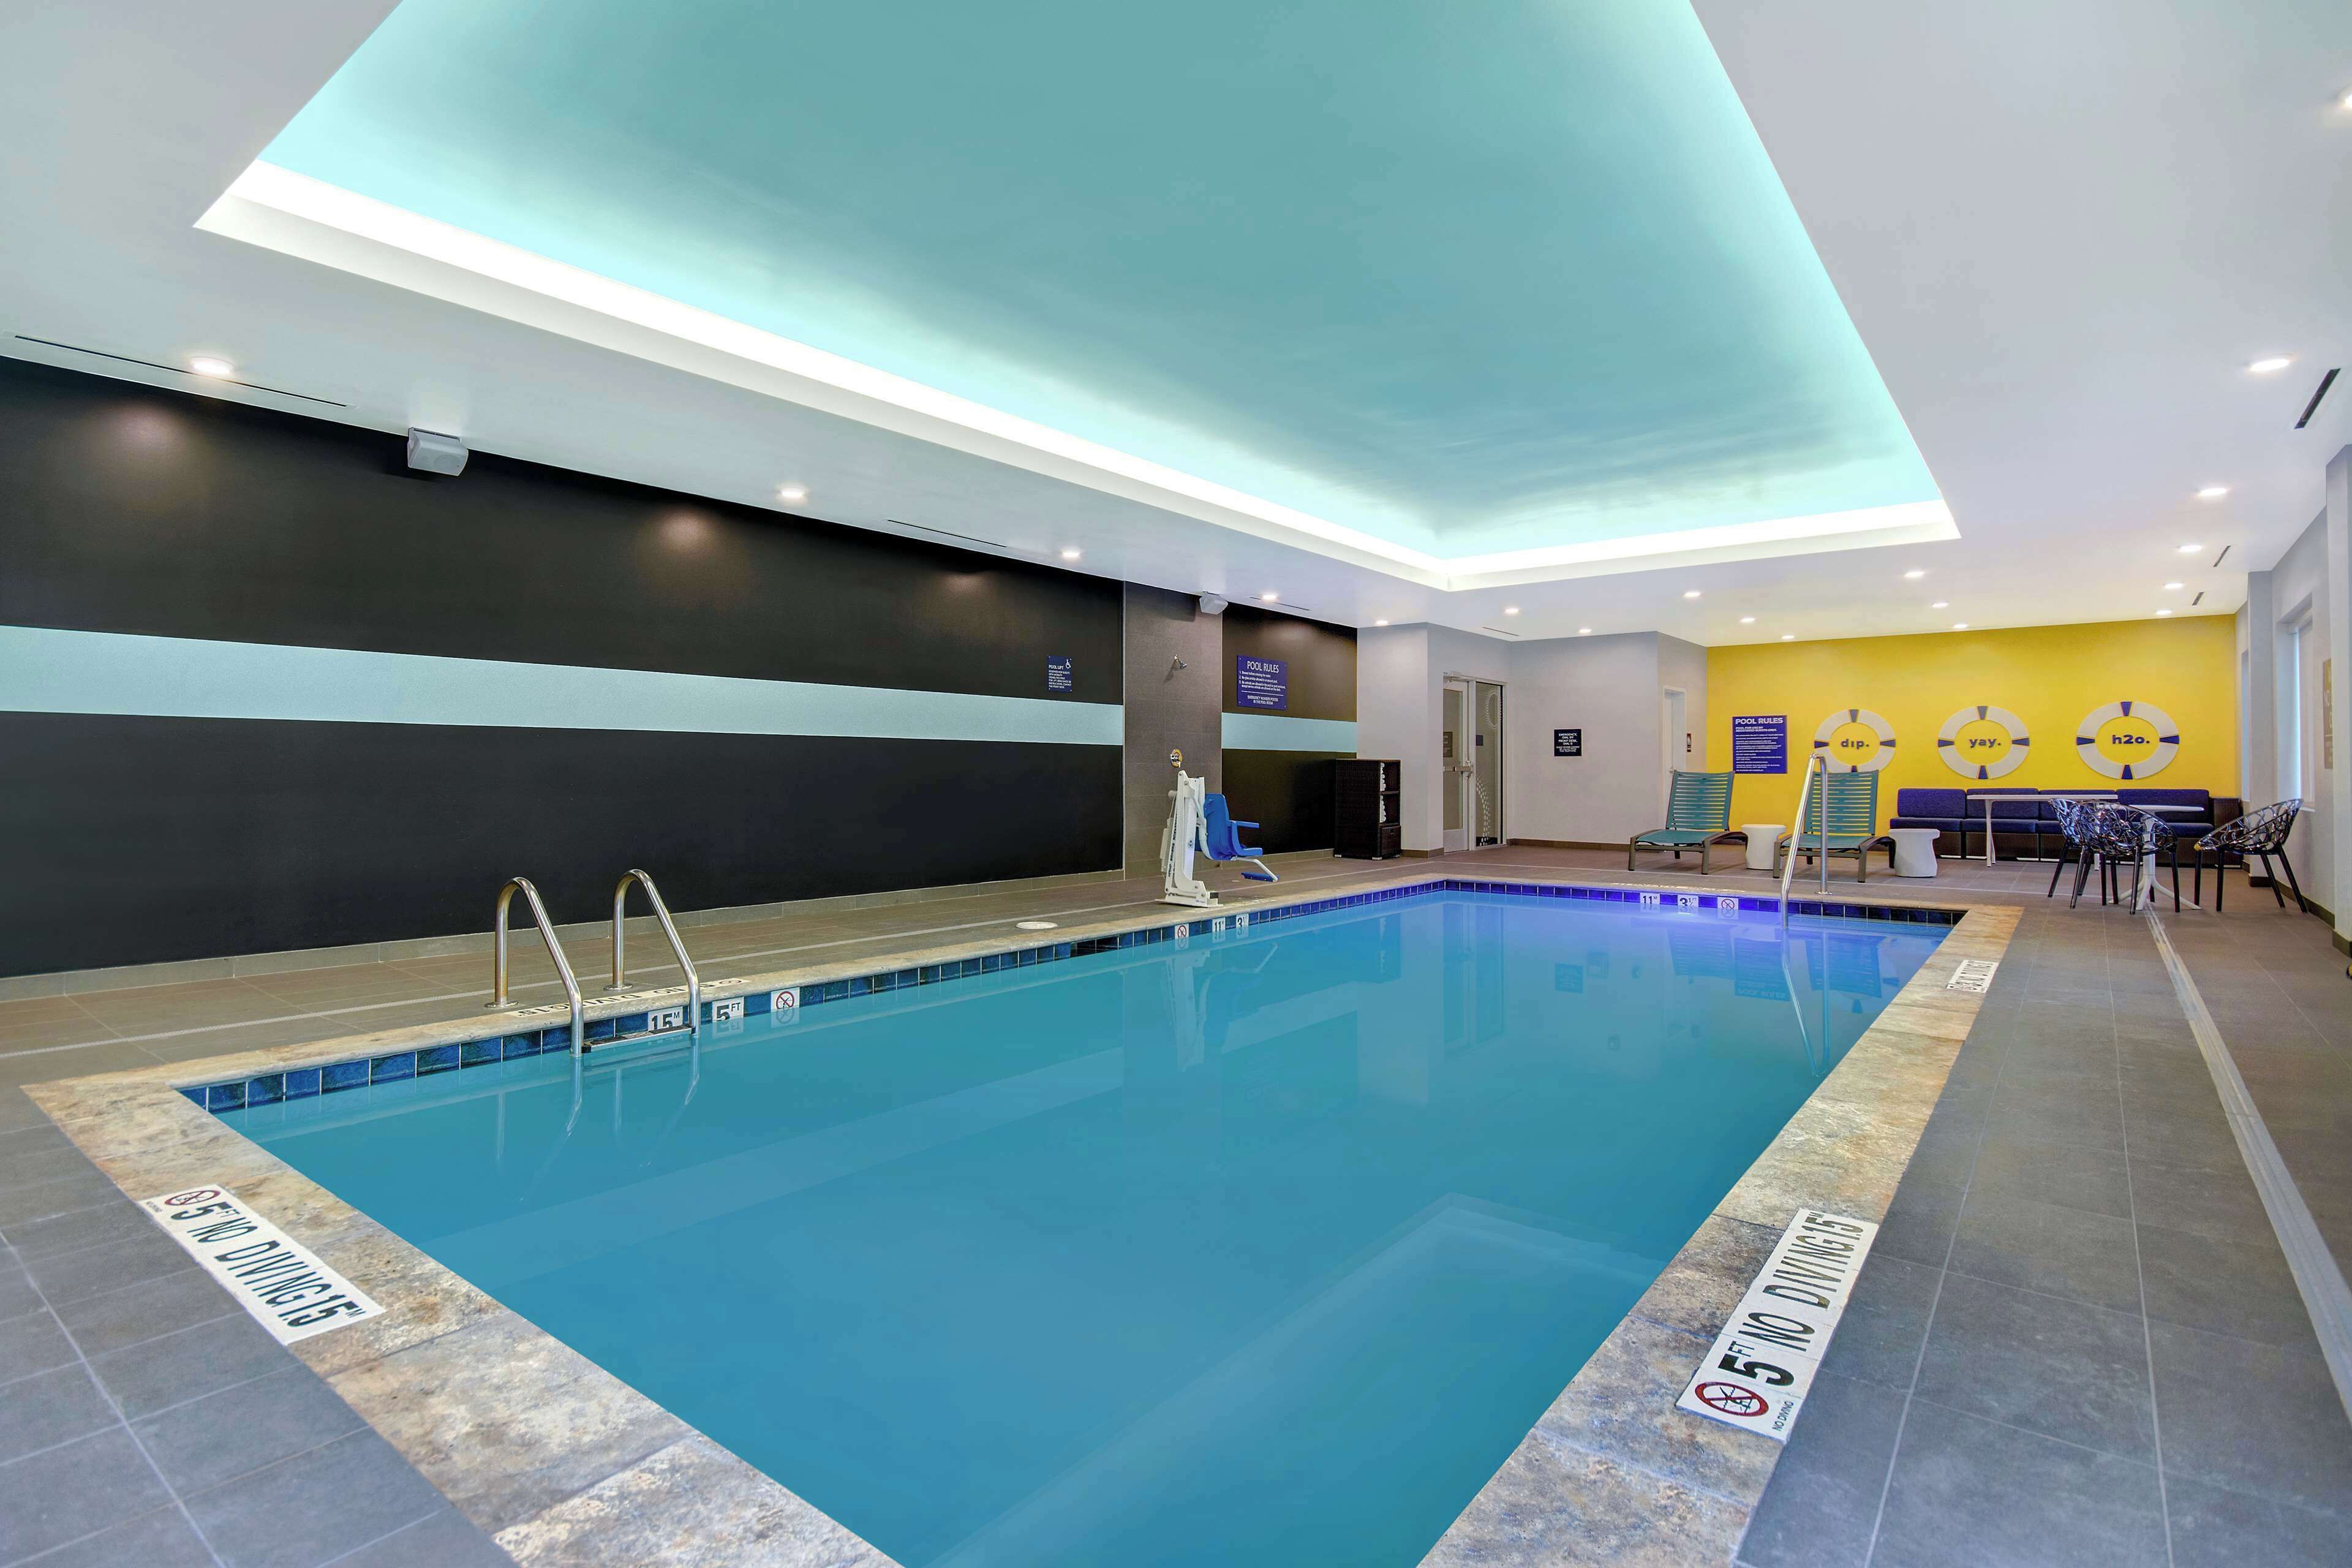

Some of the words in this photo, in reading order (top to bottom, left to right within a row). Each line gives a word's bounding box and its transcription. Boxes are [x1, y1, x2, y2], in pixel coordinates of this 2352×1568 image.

[1248, 661, 1262, 671] POOL
[1264, 663, 1279, 673] RULES
[1841, 739, 1869, 749] dip.
[1969, 739, 2001, 748] yay.
[2113, 734, 2150, 744] h2o.
[187, 1217, 258, 1243] NO
[214, 1240, 332, 1308] DIVING
[1762, 1235, 1855, 1310] DIVING
[1738, 1312, 1815, 1352] NO
[1777, 1401, 1794, 1421] DIVING
[1772, 1421, 1784, 1431] NO
